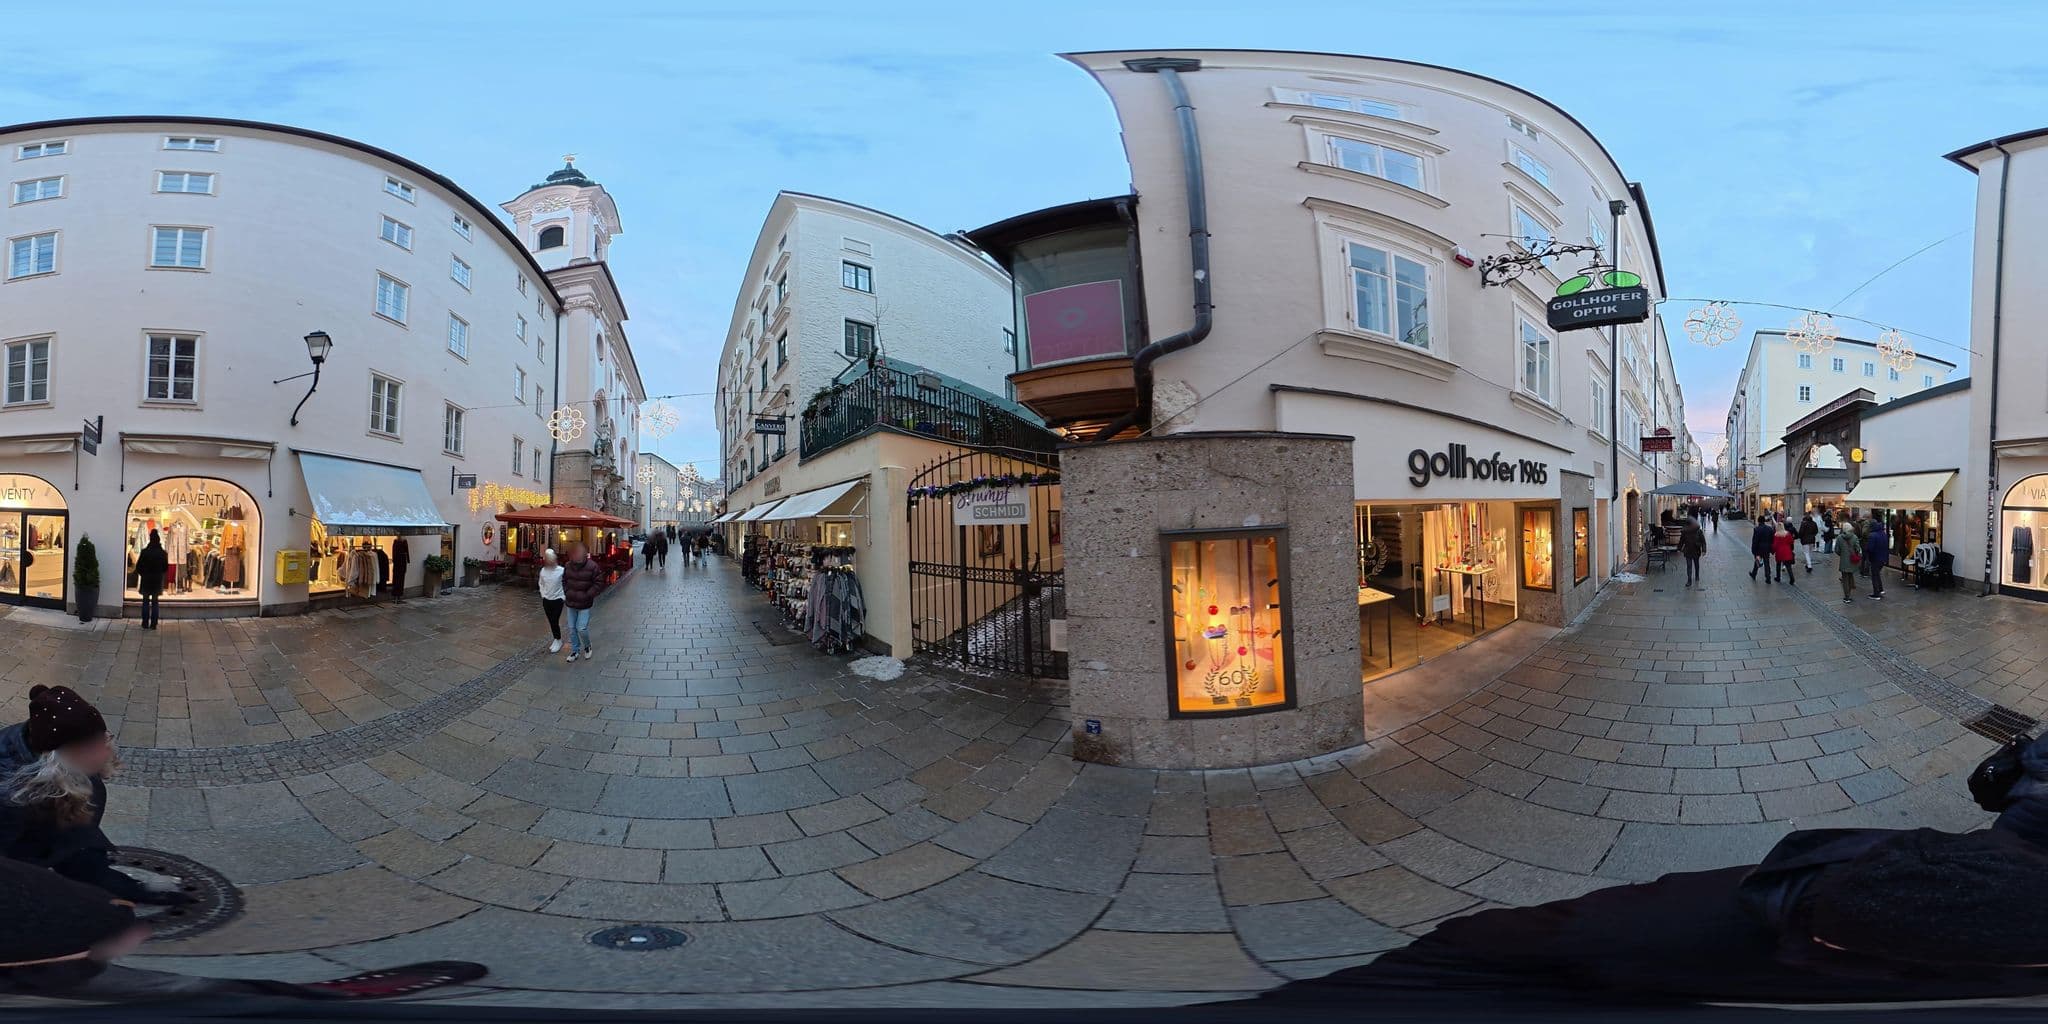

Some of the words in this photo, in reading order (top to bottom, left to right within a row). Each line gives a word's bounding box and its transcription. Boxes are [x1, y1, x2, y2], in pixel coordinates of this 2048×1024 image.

[1552, 292, 1641, 310] GOLLHOFER
[1573, 305, 1617, 317] OPTIK
[1408, 443, 1517, 488] gollhofer
[1518, 459, 1547, 485] 1965
[1, 487, 36, 500] VENTY
[168, 492, 187, 505] VIA
[190, 493, 229, 507] VENTY
[2031, 488, 2047, 500] VIA
[1219, 670, 1244, 685] 60
